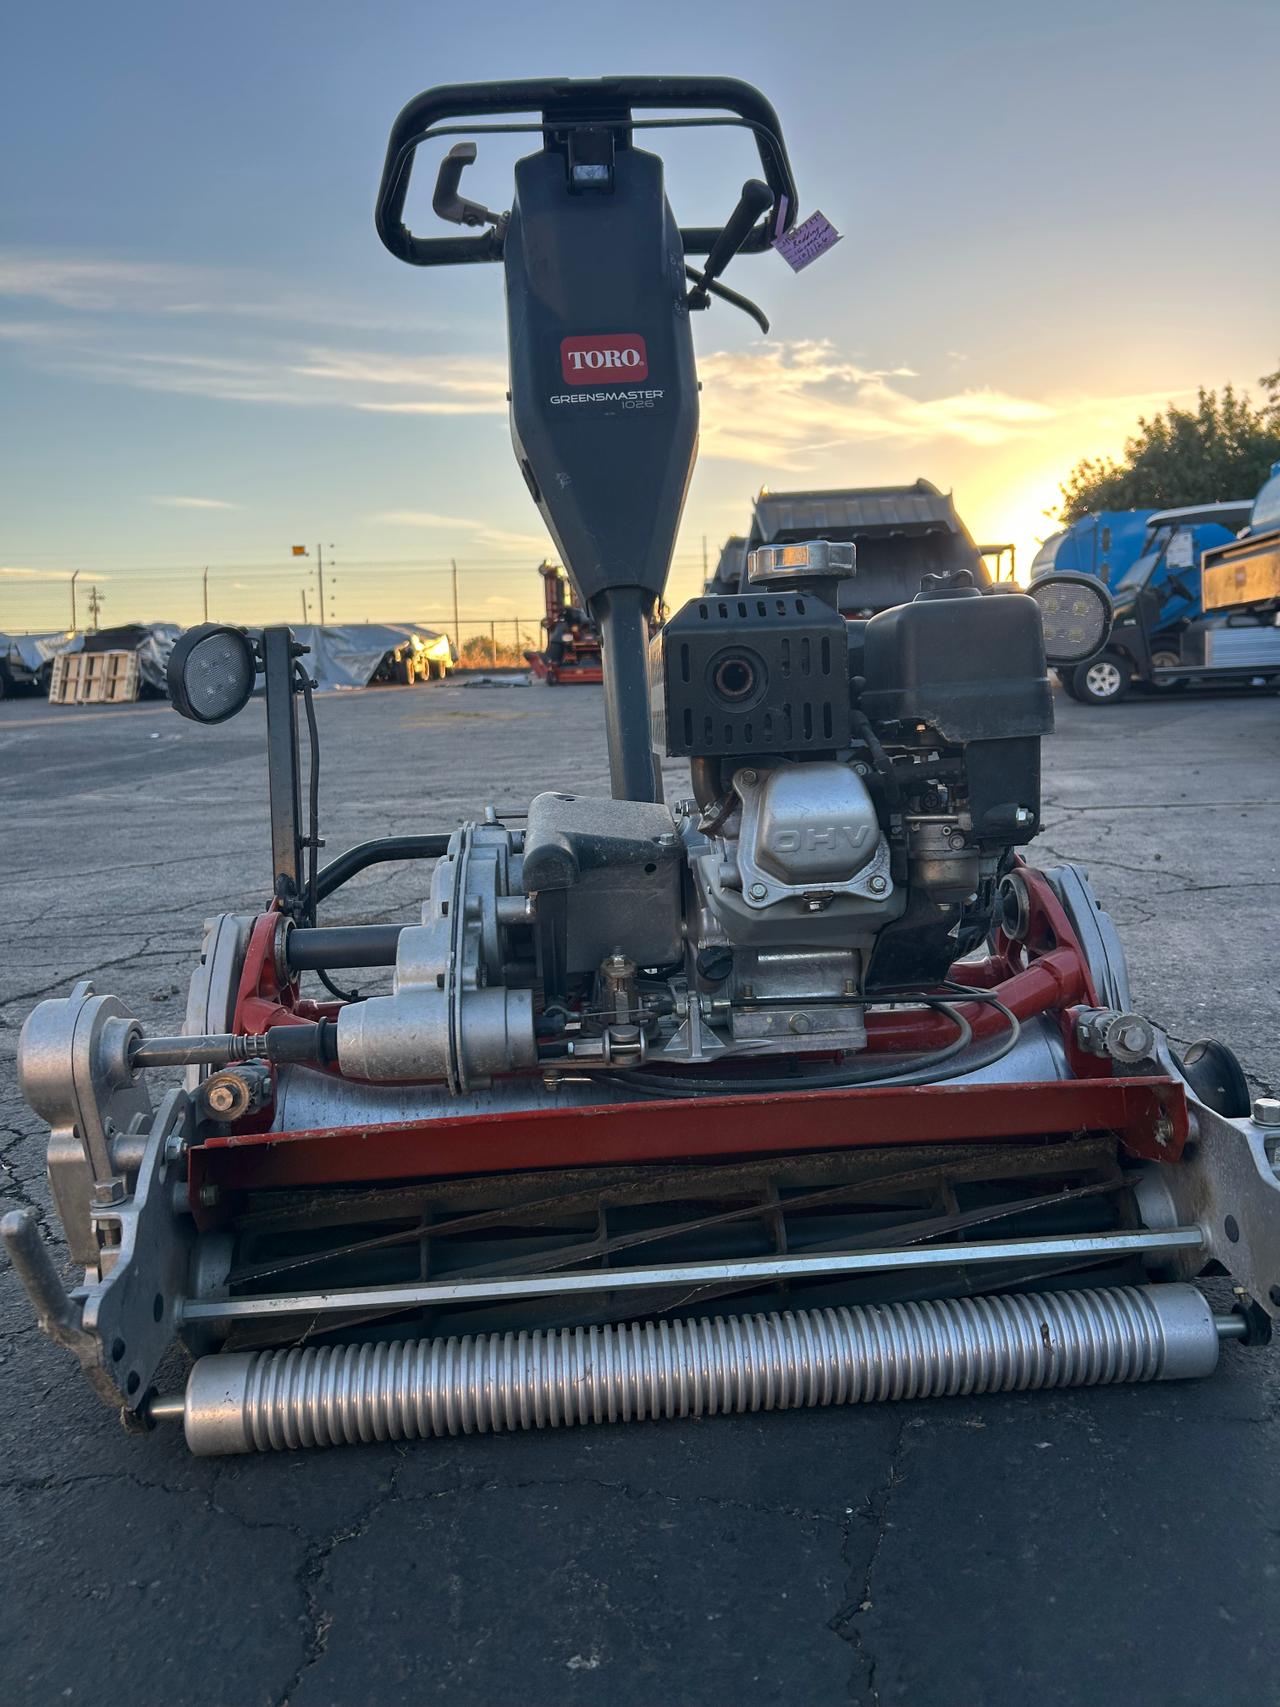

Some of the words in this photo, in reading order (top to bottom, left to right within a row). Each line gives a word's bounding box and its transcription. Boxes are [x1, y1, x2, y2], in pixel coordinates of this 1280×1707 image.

[568, 349, 641, 369] TORO
[550, 390, 663, 404] GREENSMASTER
[622, 400, 654, 409] 1026
[772, 825, 872, 853] OHV
